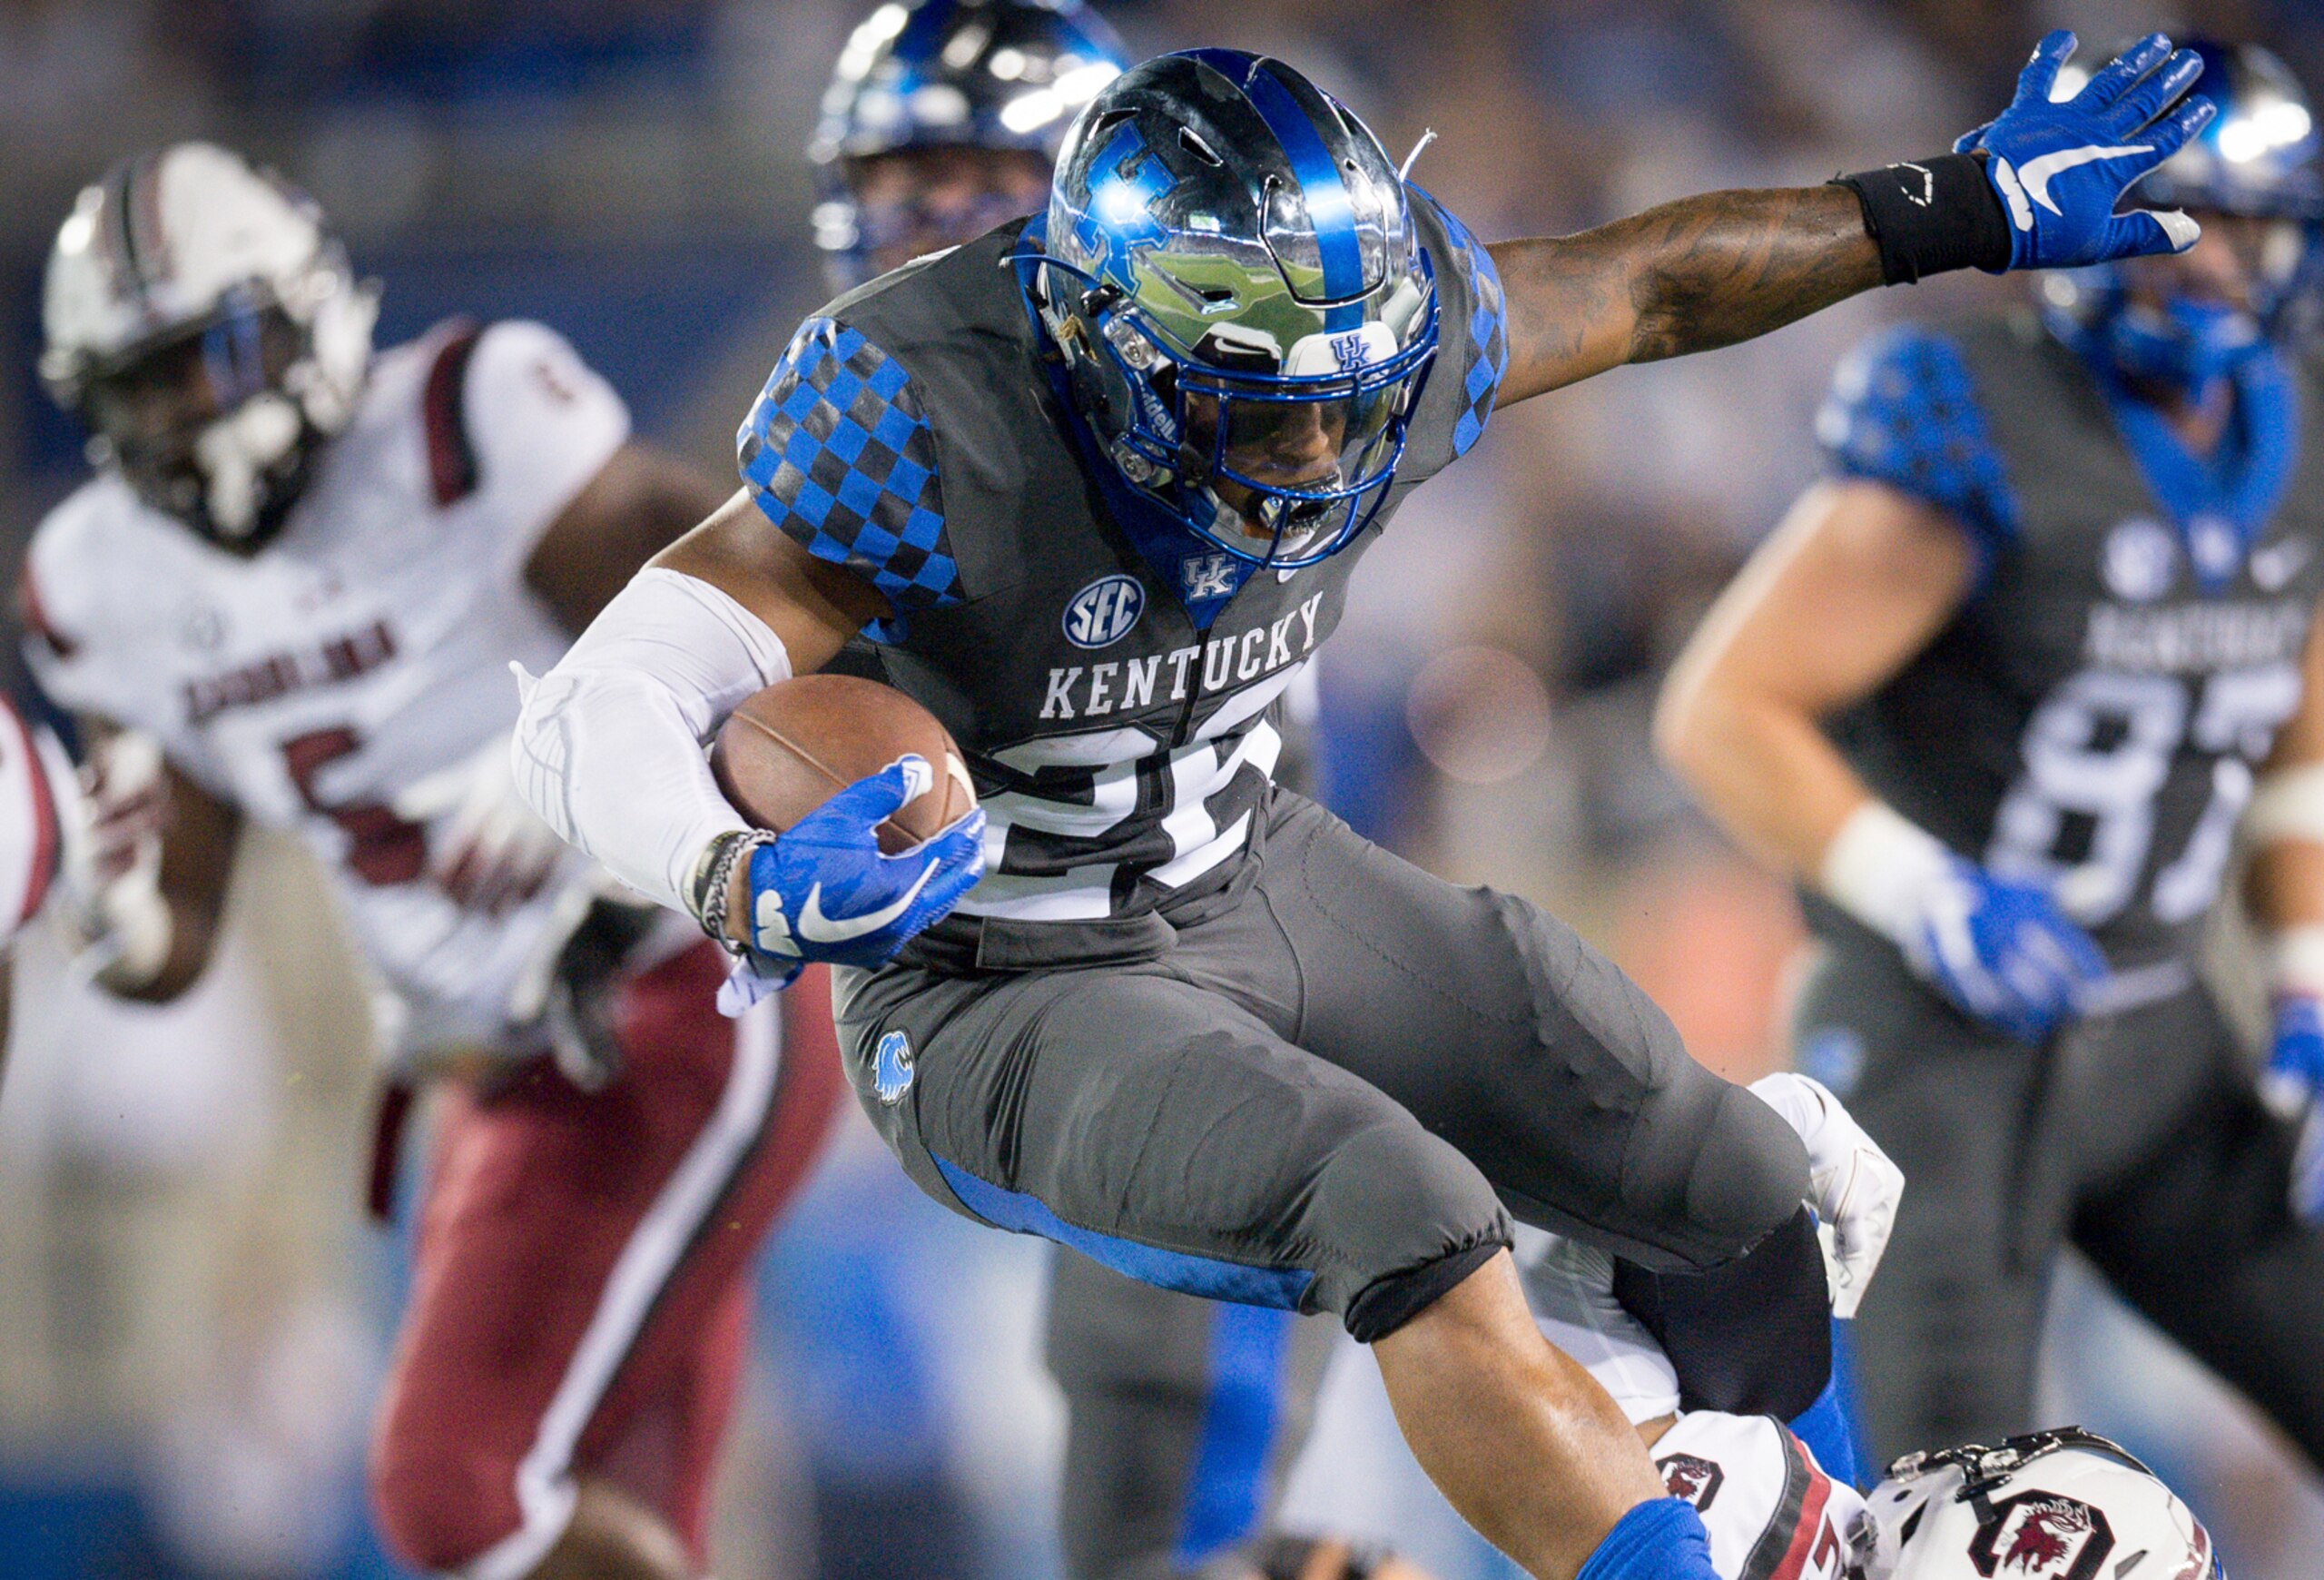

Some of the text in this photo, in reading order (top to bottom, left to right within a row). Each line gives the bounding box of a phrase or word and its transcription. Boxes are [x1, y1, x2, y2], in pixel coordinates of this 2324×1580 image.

[1068, 581, 1139, 644] SEC
[1184, 554, 1236, 601] UK
[1039, 590, 1324, 720] KENTUCKY
[1985, 666, 2303, 924] 87
